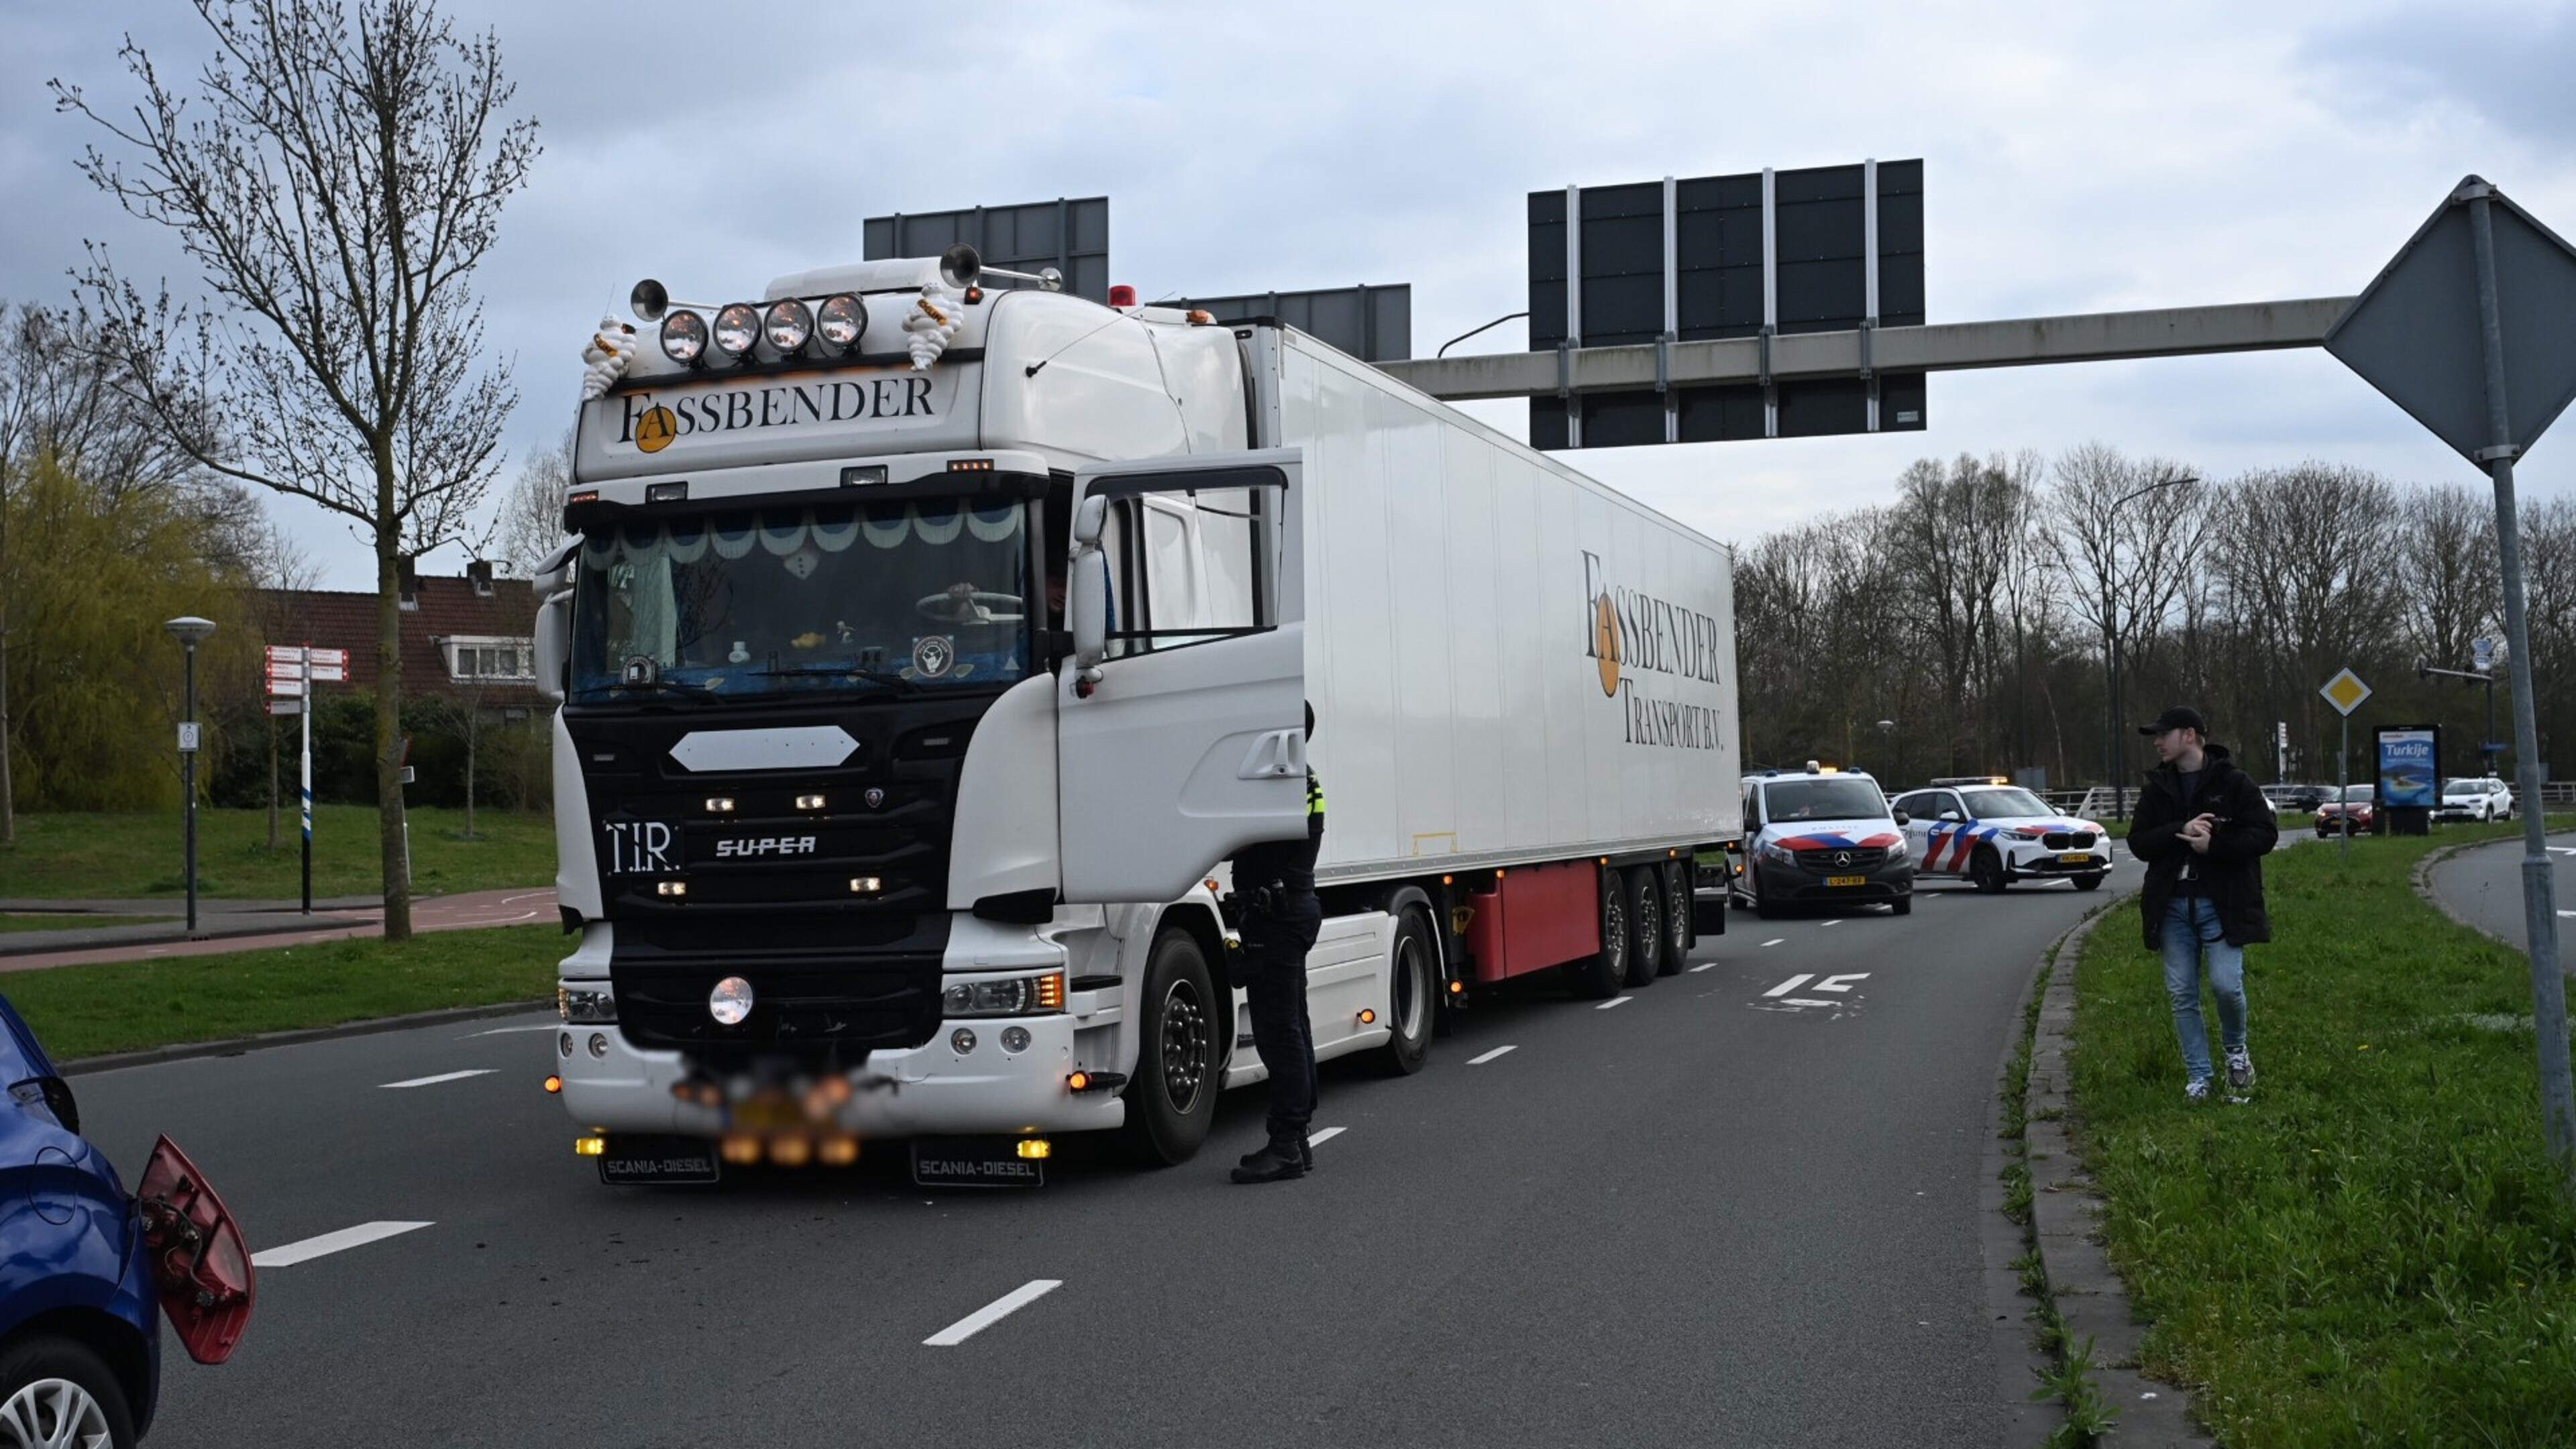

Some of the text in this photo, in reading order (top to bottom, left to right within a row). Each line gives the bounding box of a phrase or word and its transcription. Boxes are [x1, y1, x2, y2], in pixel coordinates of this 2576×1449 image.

[617, 377, 936, 443] FASSBENDER
[1581, 549, 1721, 685] FASSBENDER
[1619, 676, 1724, 751] TRANSPORT B.V.
[2385, 743, 2430, 757] Turkije
[716, 836, 816, 857] SUPER
[607, 1157, 712, 1175] SCANIA-DIESEL
[920, 1159, 1036, 1177] SCANIA-DIESEL
